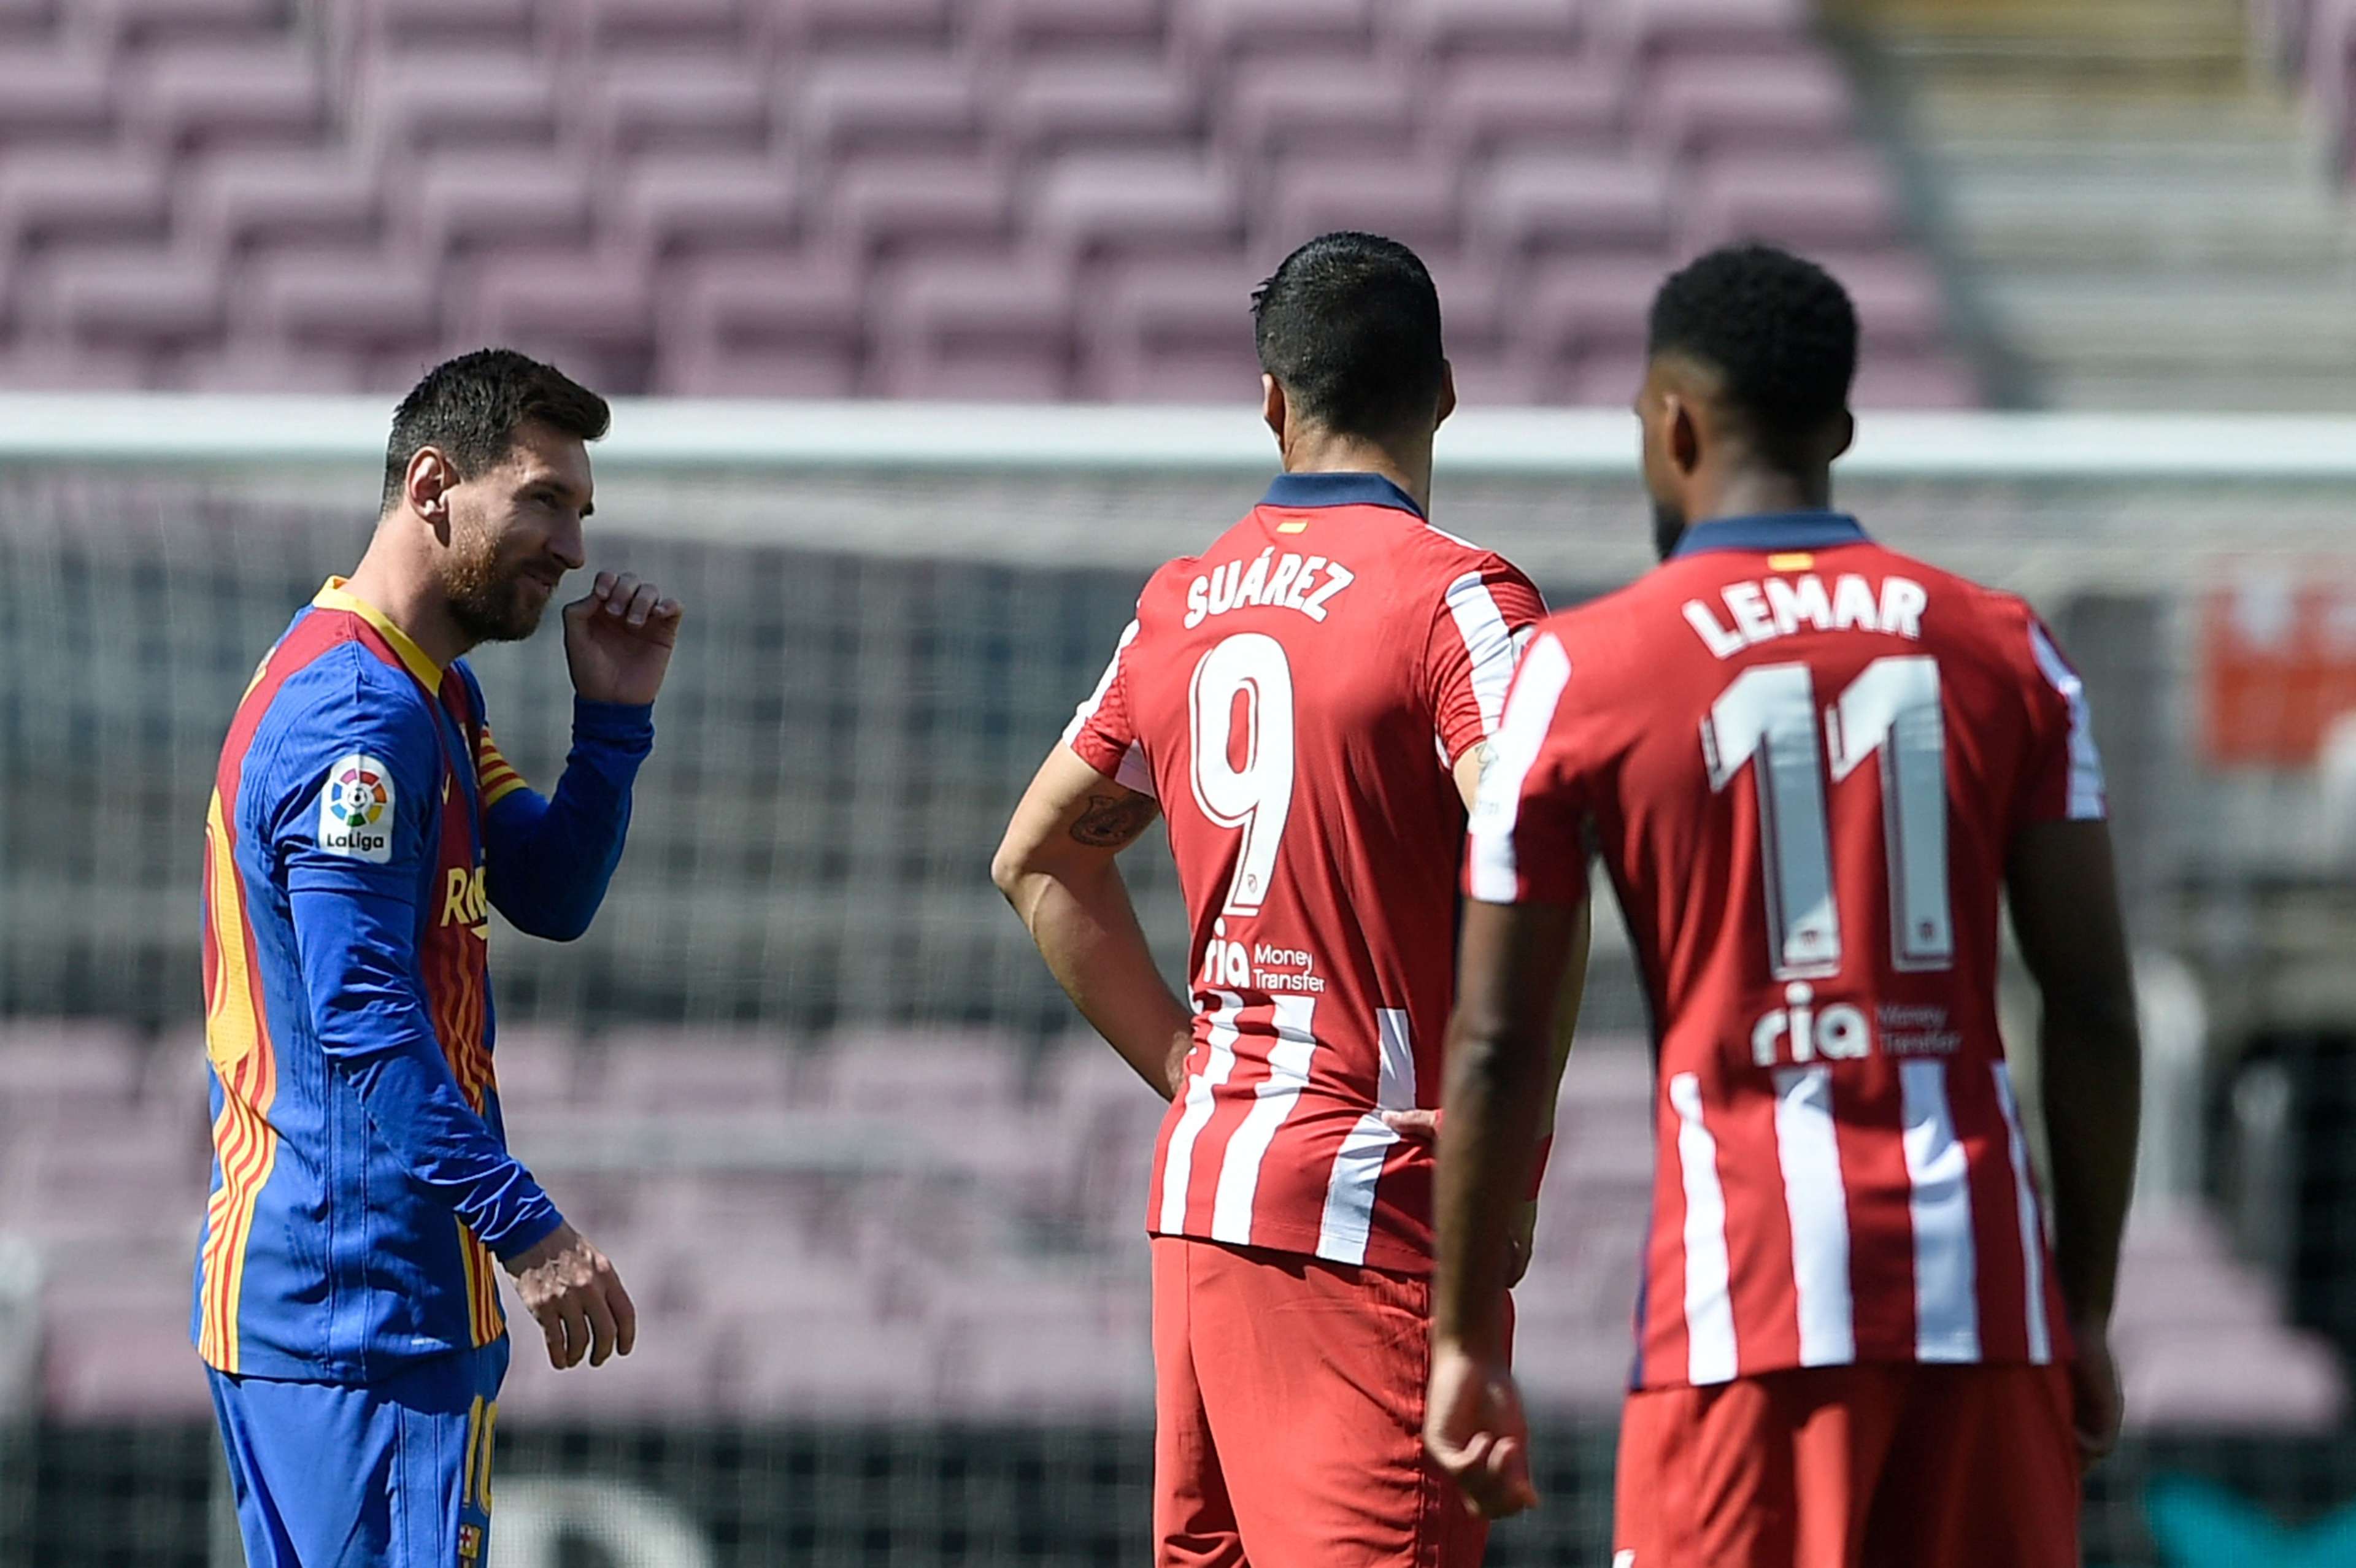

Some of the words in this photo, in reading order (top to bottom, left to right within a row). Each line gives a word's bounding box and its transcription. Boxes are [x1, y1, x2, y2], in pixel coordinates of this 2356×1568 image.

[1184, 546, 1355, 630] SUÁREZ
[1682, 574, 1928, 659] LEMAR
[1188, 632, 1295, 917] 9
[327, 831, 383, 851] LaLiga
[1698, 654, 1954, 982] 11
[1203, 917, 1250, 989] ria
[1254, 943, 1312, 974] Money
[1253, 969, 1325, 993] Transfer
[1752, 981, 1871, 1067] ria
